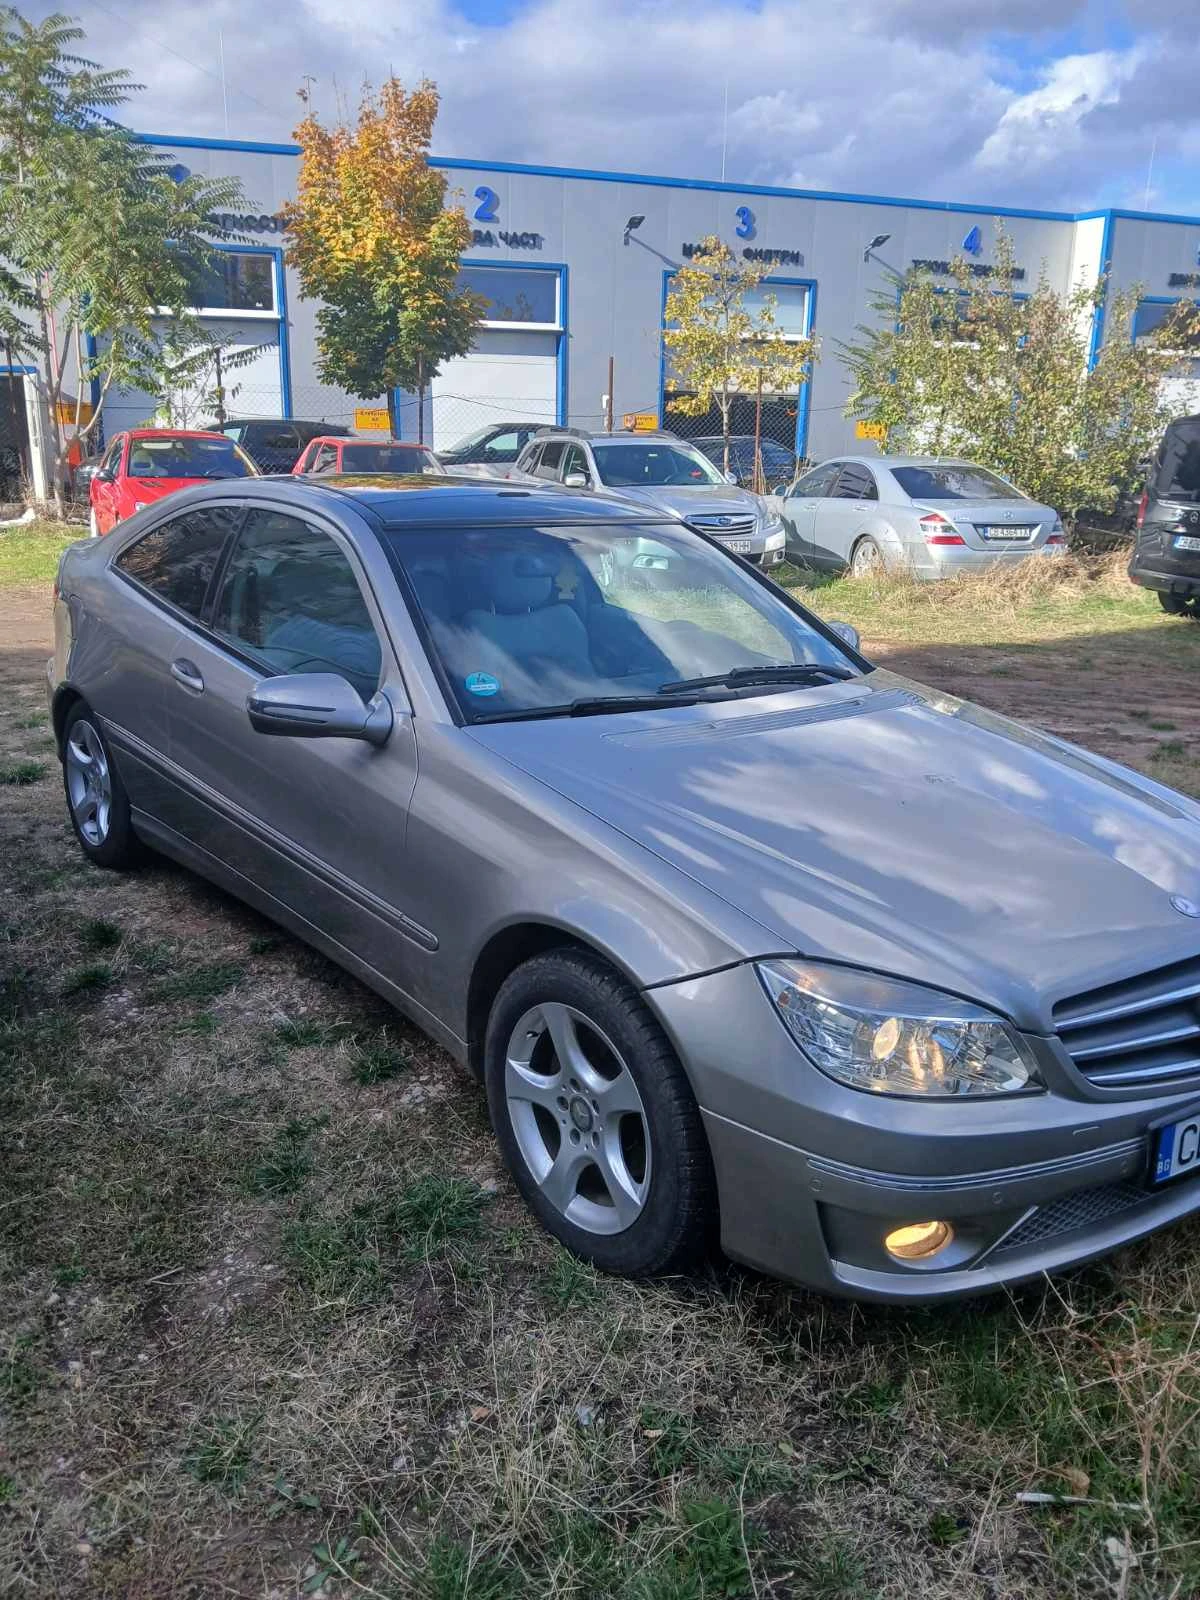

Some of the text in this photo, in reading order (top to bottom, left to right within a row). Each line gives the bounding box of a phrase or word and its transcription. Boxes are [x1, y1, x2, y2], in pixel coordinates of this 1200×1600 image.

[474, 186, 499, 222] 2
[735, 206, 755, 239] 3
[498, 230, 543, 249] ЧАСТ
[961, 224, 981, 257] 4
[1178, 1122, 1200, 1166] C
[1156, 1158, 1171, 1175] BG
